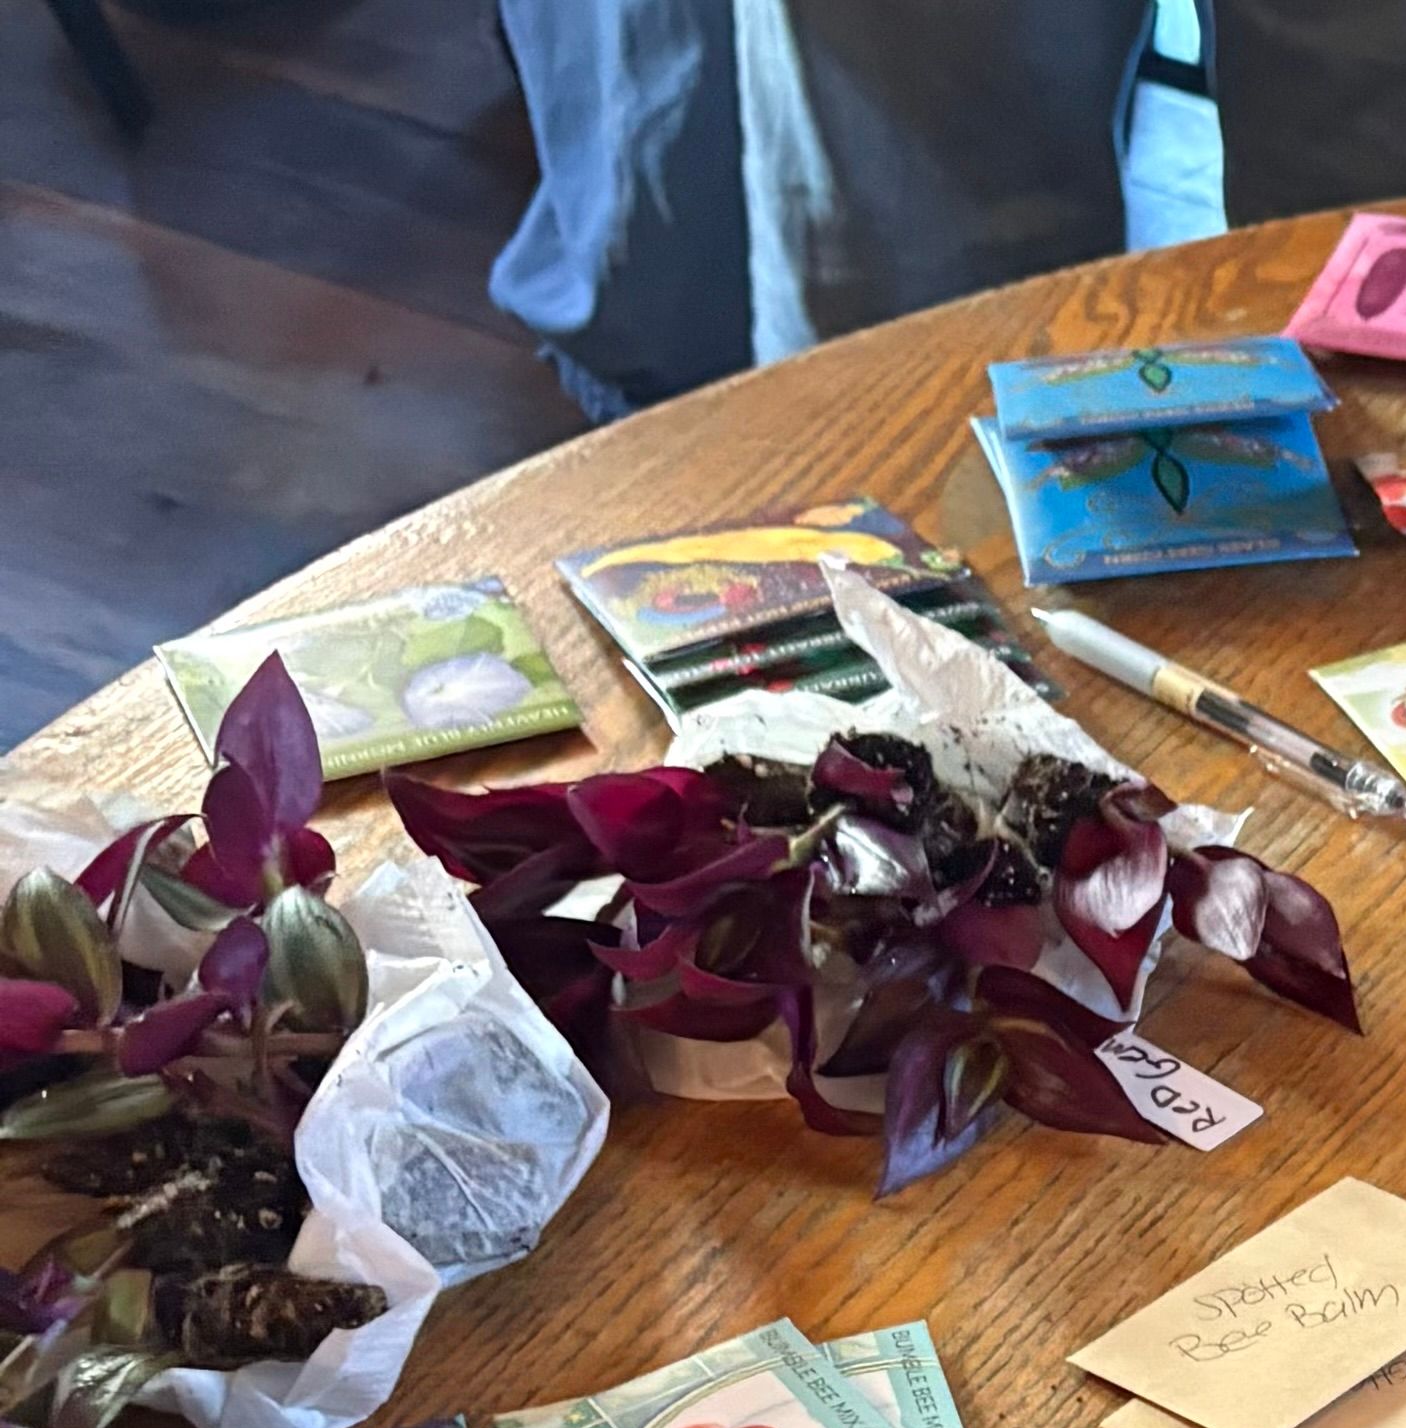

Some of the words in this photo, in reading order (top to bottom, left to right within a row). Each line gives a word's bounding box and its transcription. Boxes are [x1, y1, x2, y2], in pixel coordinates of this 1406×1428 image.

[1169, 1316, 1274, 1365] Bee
[1289, 1281, 1401, 1330] Balm
[1192, 1253, 1338, 1323] Spotted
[760, 1329, 817, 1381] BUMBLE
[806, 1374, 841, 1405] BEE
[891, 1329, 928, 1388] BUMBLE
[912, 1385, 939, 1415] BEE
